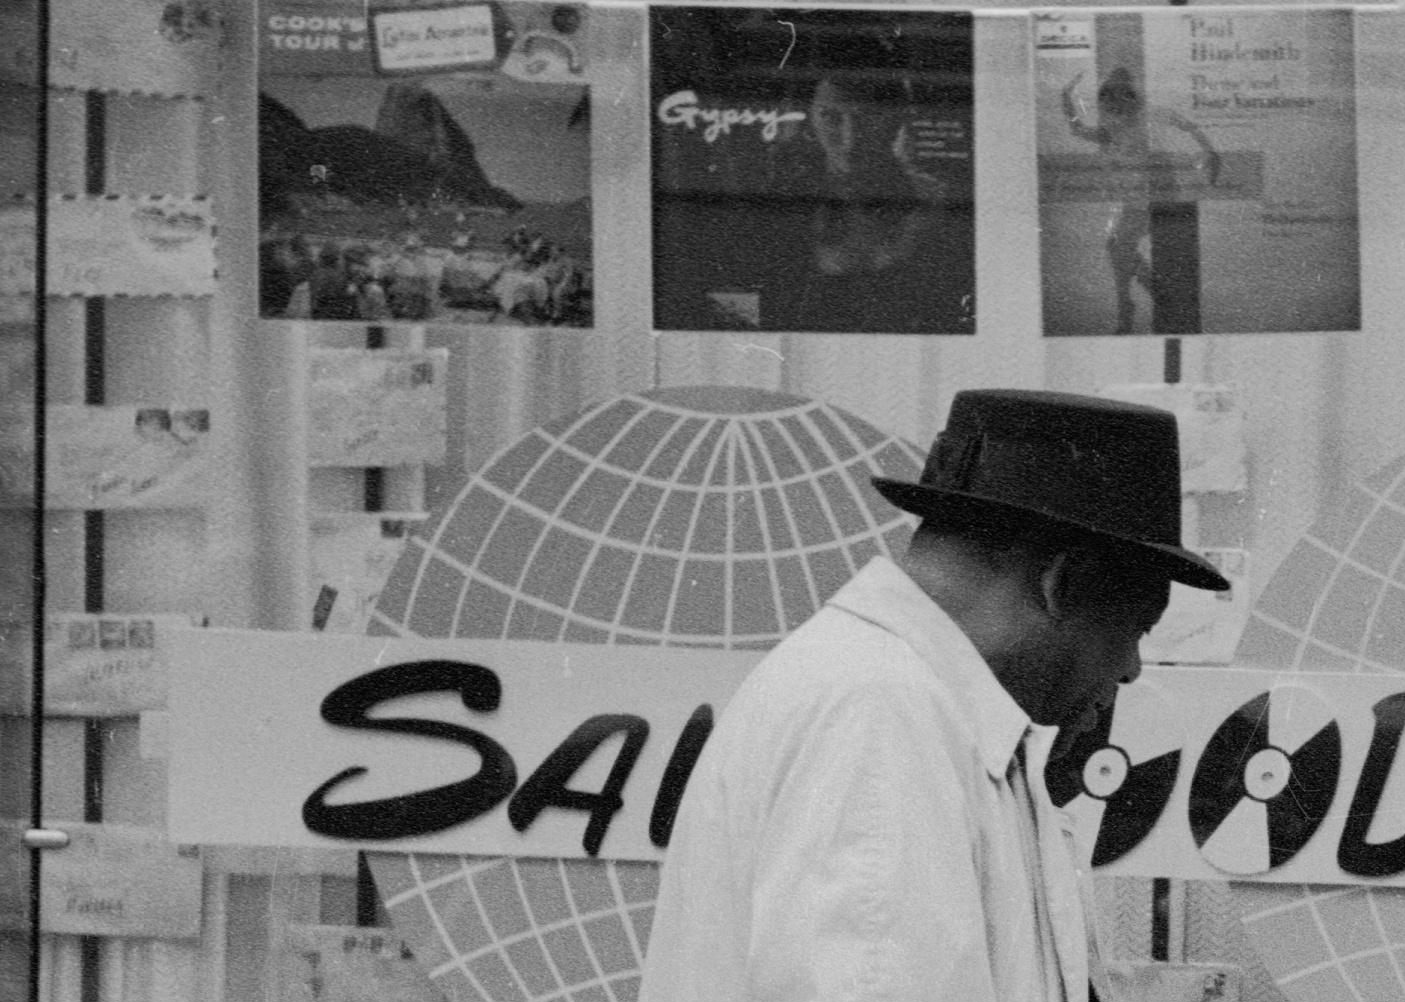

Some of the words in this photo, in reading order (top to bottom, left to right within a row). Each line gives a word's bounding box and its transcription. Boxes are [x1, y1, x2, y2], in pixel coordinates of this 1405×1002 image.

[269, 34, 340, 51] TOUR
[657, 89, 807, 144] Gypsy
[302, 659, 712, 858] SA
